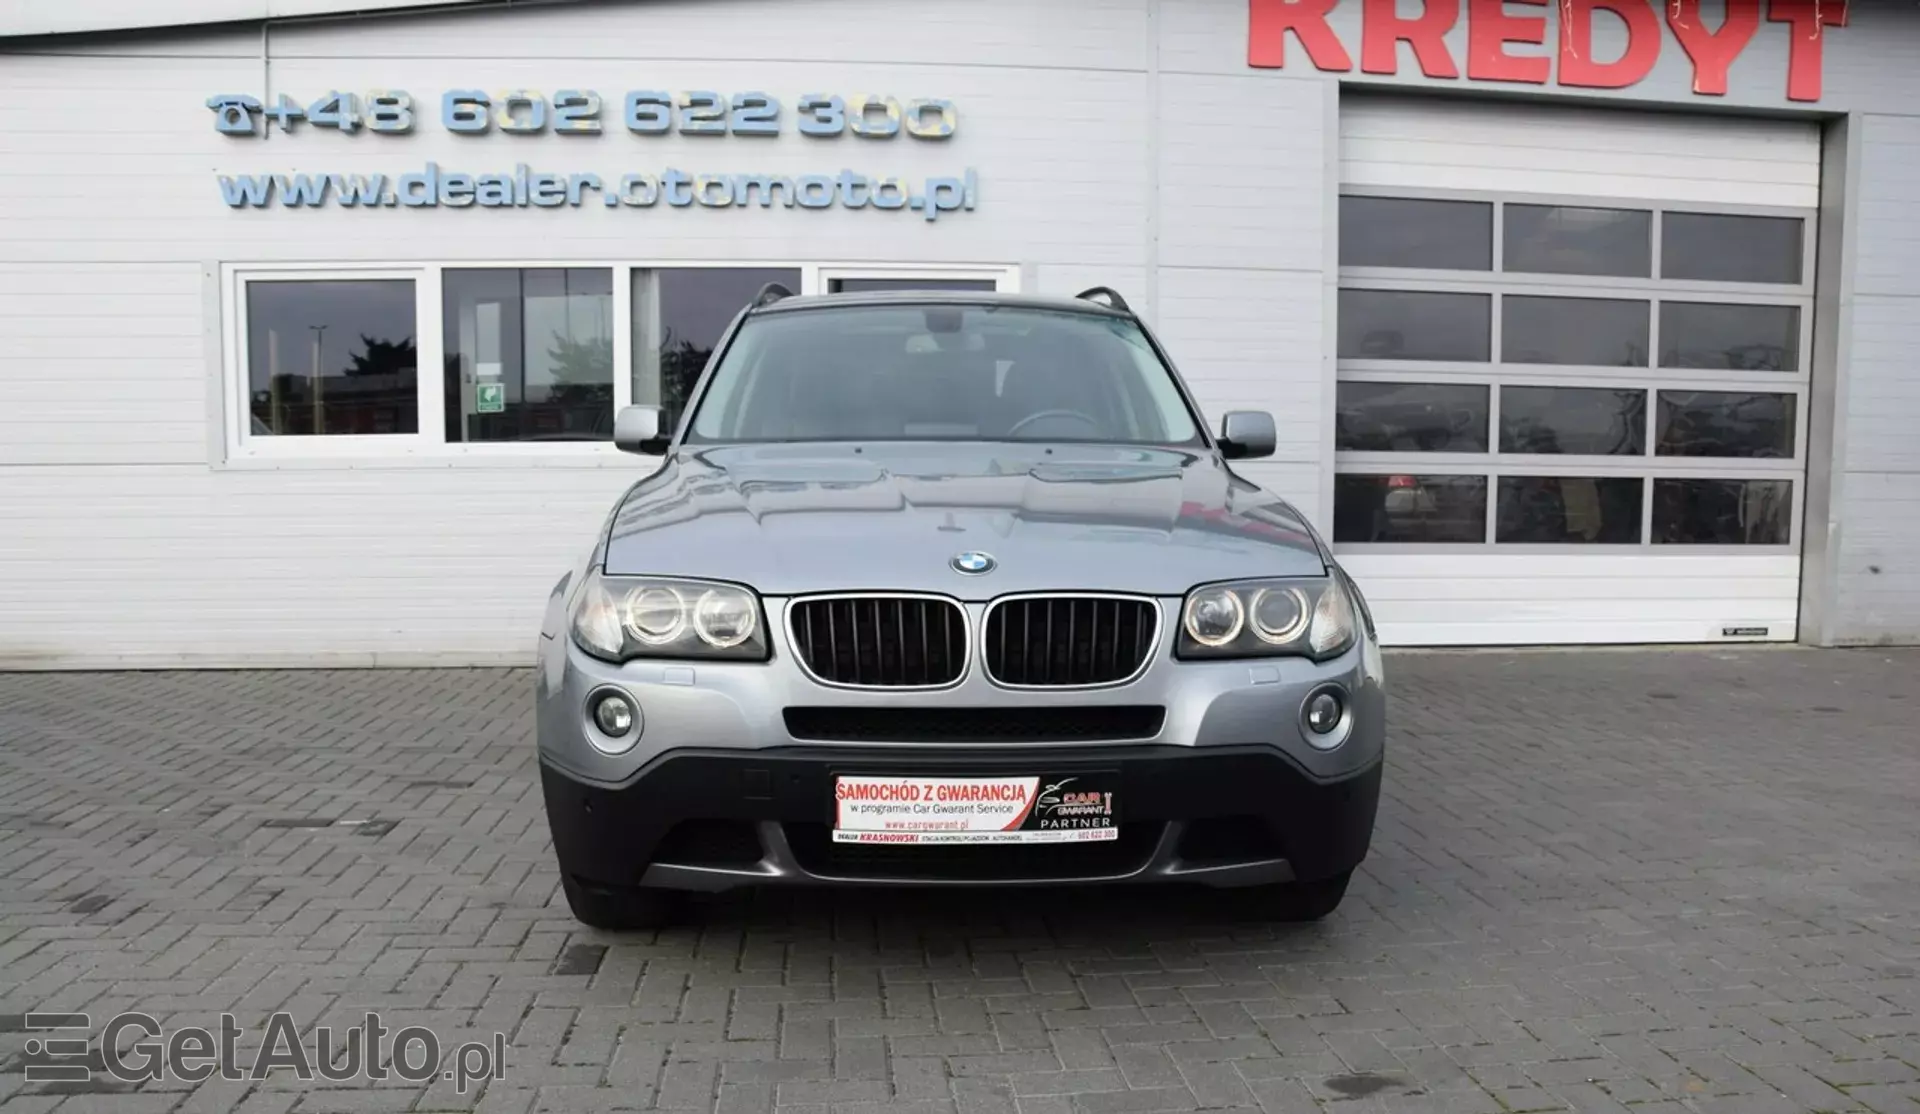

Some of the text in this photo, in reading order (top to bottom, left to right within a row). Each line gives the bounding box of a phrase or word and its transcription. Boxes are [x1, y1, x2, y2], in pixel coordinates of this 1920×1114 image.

[1247, 0, 1849, 102] KREDYT
[264, 89, 957, 140] +48 602 622 300
[214, 161, 980, 223] www.dealer.otomoto.pl
[836, 780, 1027, 805] SAMOCHÓD Z GWARANCJĄ
[1063, 792, 1101, 805] CAR
[850, 803, 1014, 815] w programie Car Gwarant Service
[1057, 806, 1104, 816] GWARANT
[1040, 817, 1111, 829] PARTNER
[859, 832, 920, 843] KRASNOWSKI
